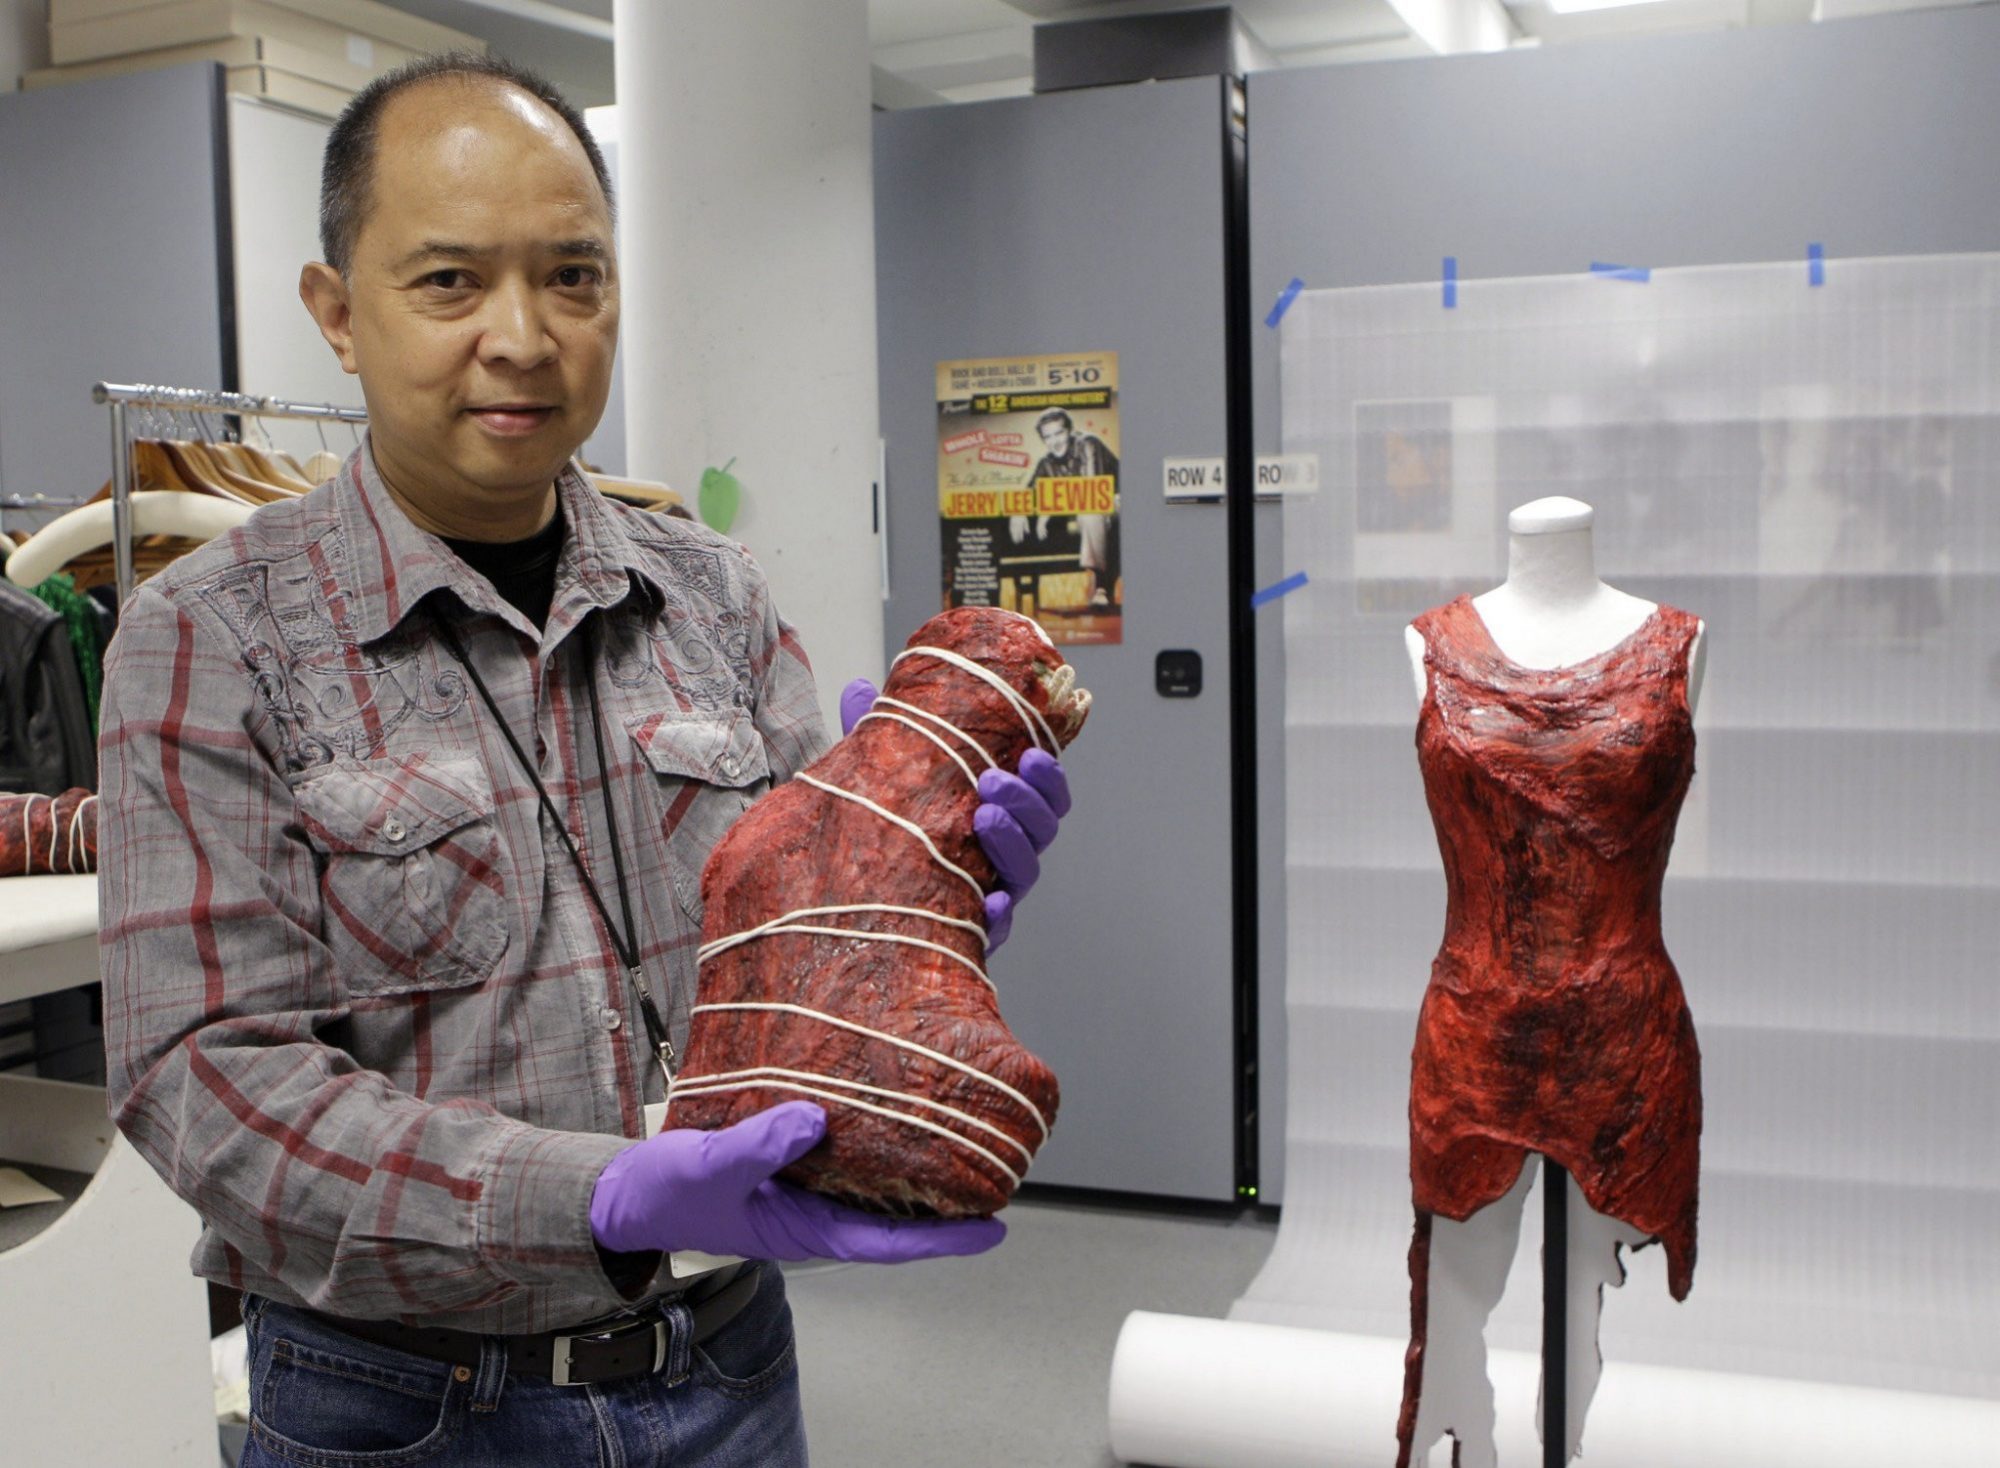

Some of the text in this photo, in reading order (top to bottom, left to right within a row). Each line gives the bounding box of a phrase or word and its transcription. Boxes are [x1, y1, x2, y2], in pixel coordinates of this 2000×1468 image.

[1168, 465, 1222, 486] ROW 4
[947, 479, 1111, 516] JERRY LEE LEWIS
